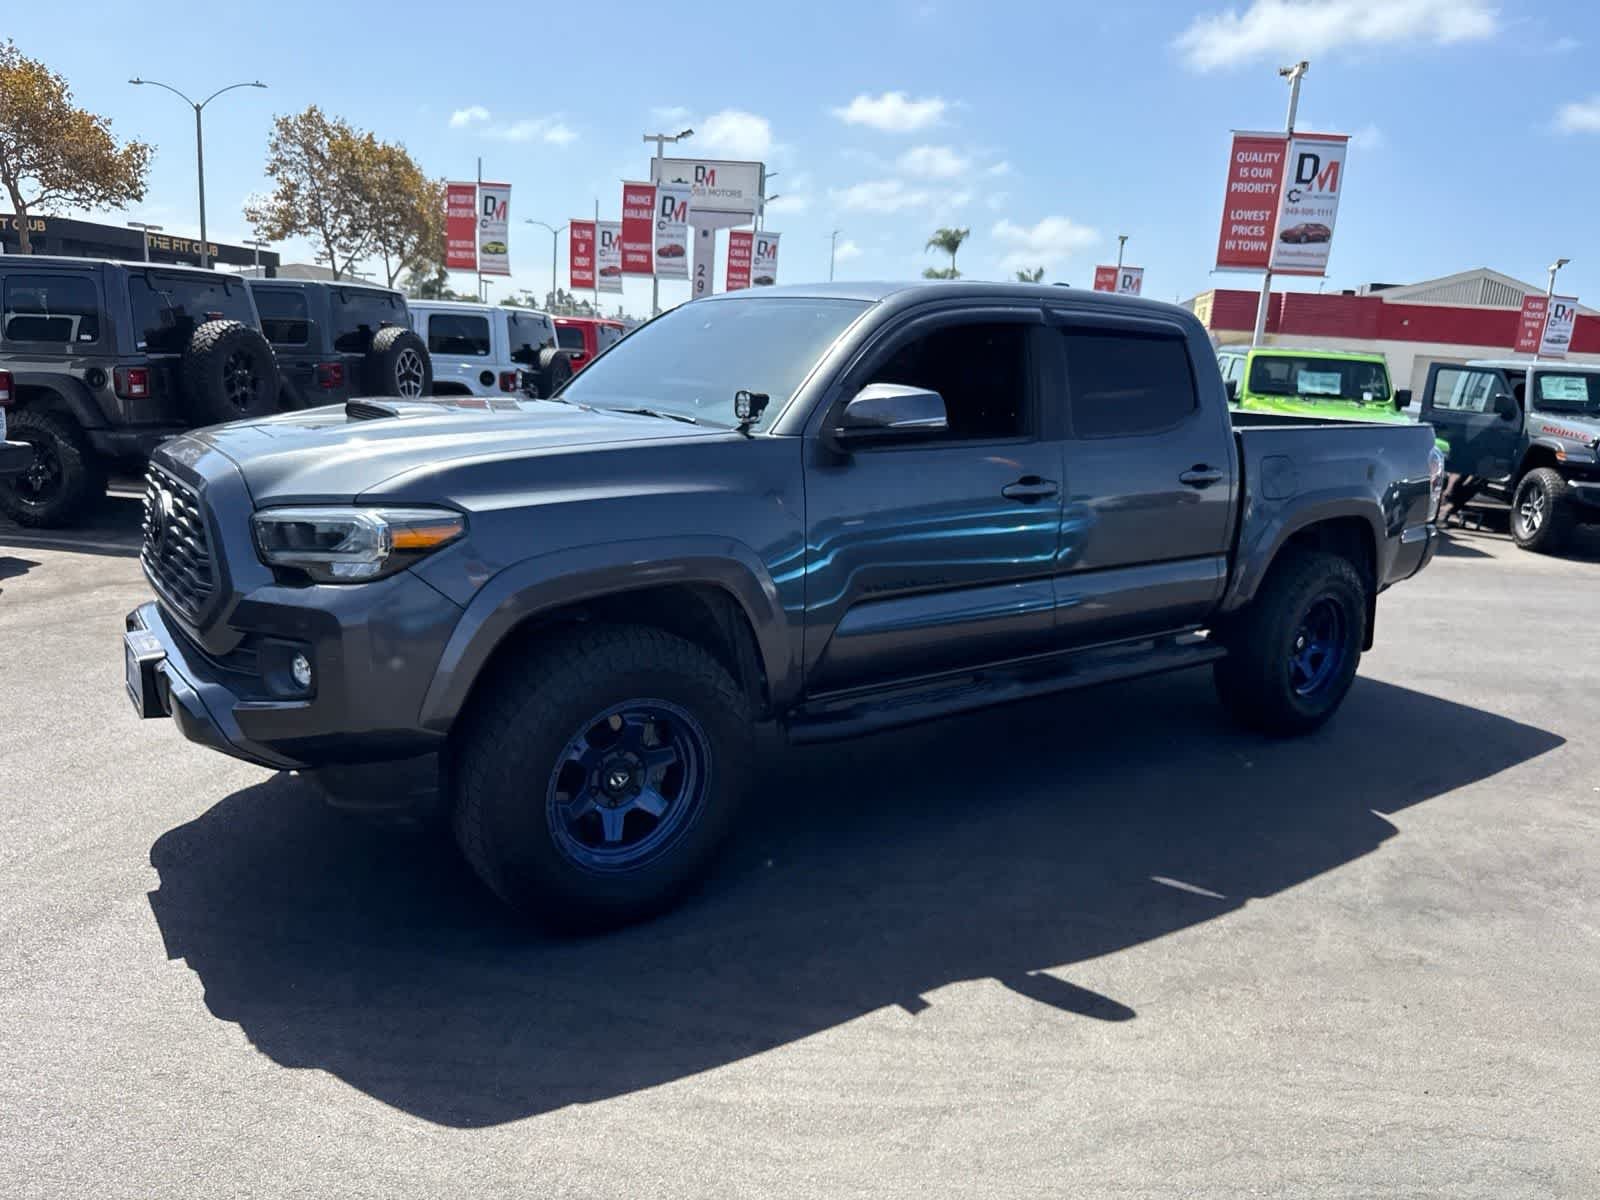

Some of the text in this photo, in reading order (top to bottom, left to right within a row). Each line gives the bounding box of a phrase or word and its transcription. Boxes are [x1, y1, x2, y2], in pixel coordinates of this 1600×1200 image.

[1236, 152, 1280, 163] QUALITY
[1239, 168, 1272, 178] IS OUR
[1295, 153, 1340, 192] DM
[708, 189, 742, 198] MOTORS
[1231, 183, 1277, 194] PRIORITY
[1230, 210, 1271, 221] LOWEST
[1231, 225, 1265, 236] PRICES
[148, 235, 170, 249] THE
[172, 239, 191, 252] FIT
[1225, 240, 1267, 251] IN TOWN
